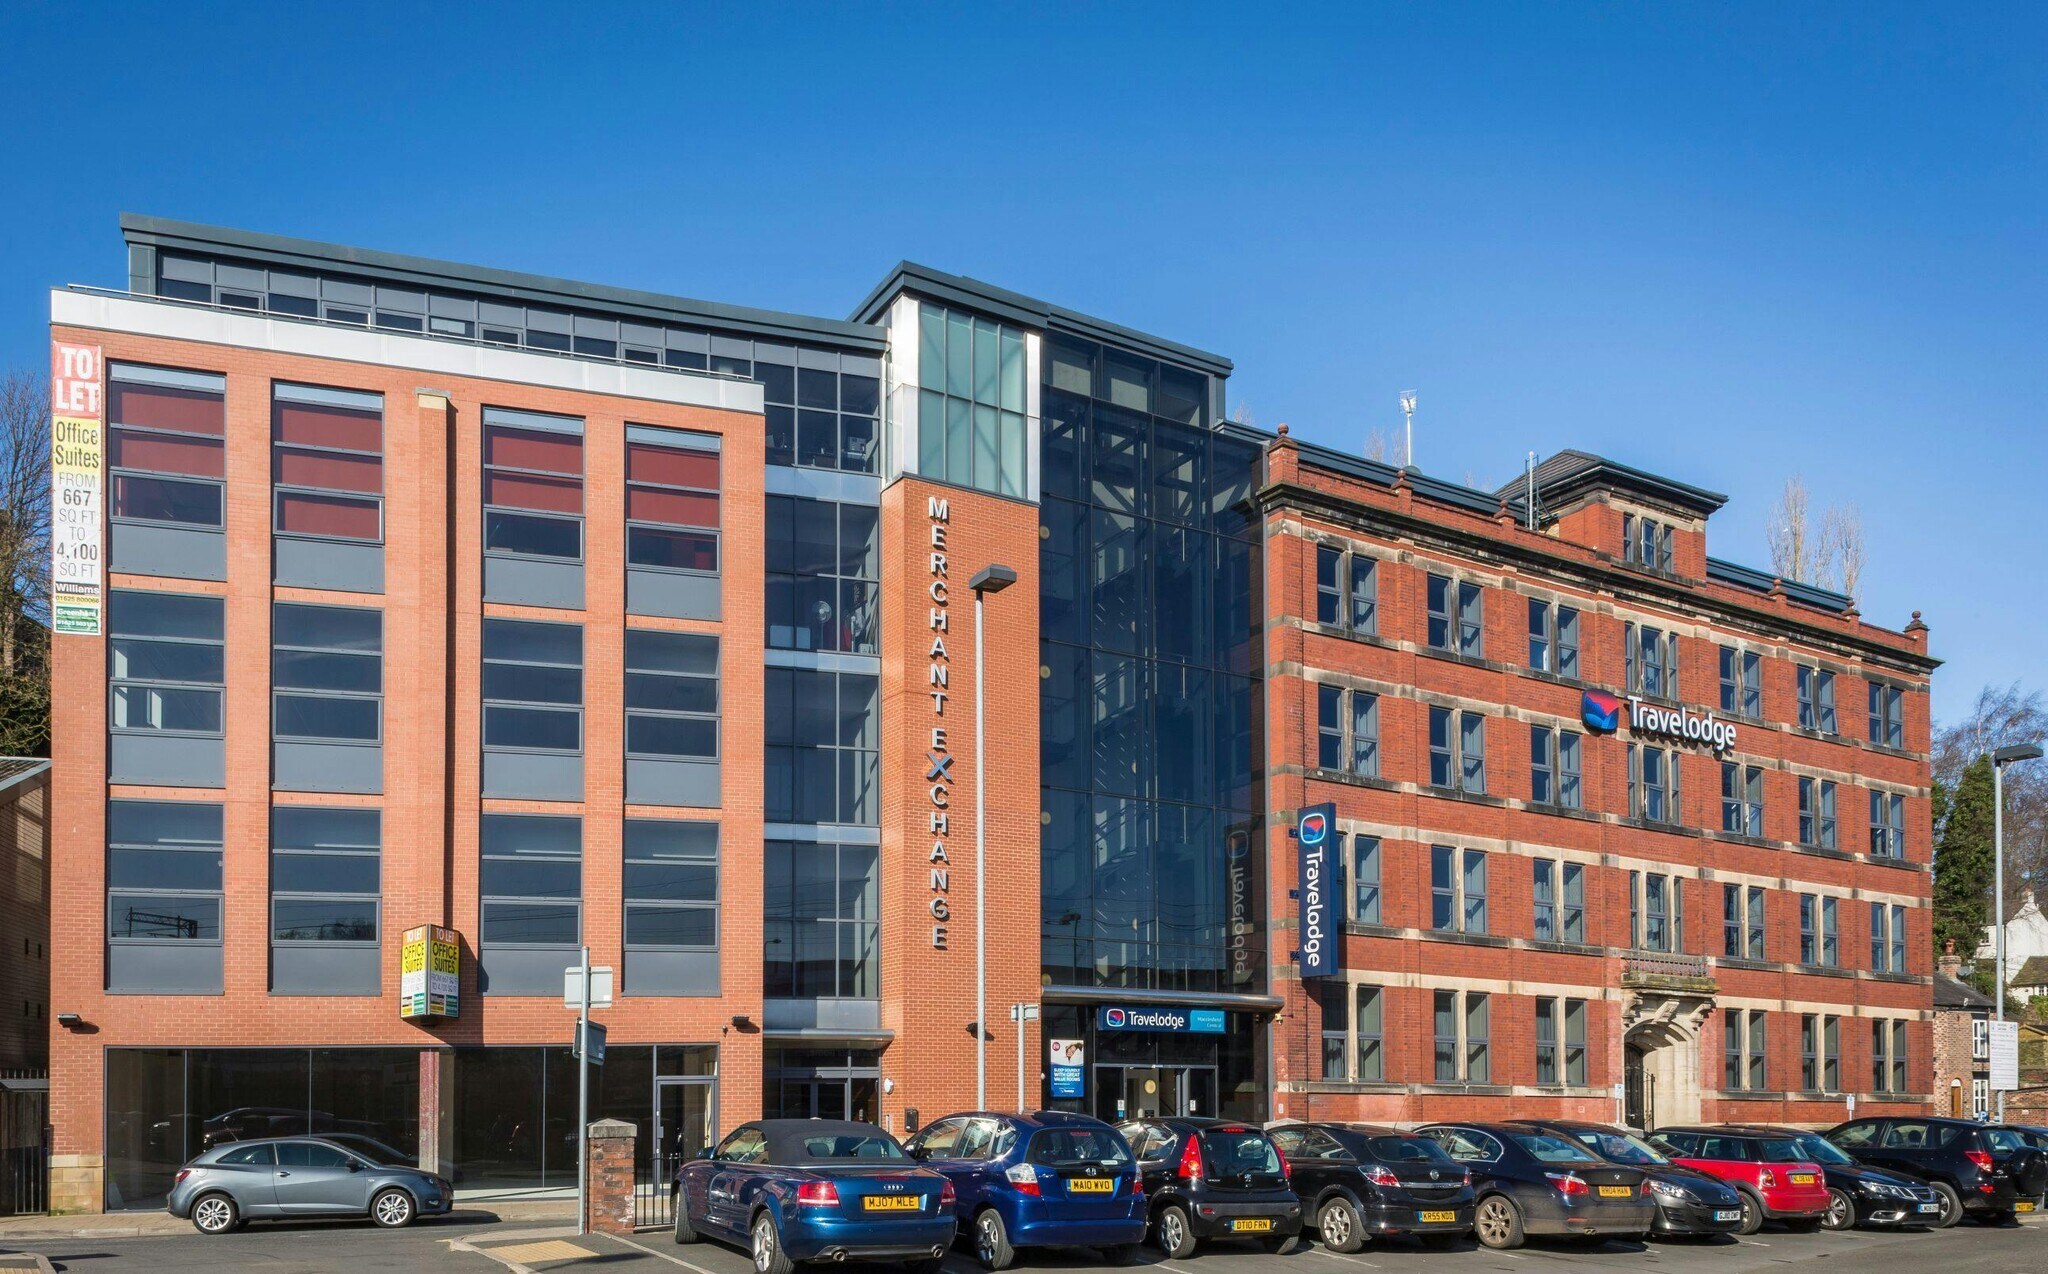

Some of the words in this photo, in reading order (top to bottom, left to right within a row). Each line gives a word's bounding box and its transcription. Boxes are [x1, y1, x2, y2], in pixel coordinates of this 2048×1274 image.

[61, 347, 93, 379] TO
[56, 378, 100, 412] LET
[56, 421, 98, 445] Office
[55, 445, 99, 468] Suites
[59, 472, 95, 488] FROM
[63, 488, 91, 506] 667
[59, 508, 77, 523] SQ
[81, 510, 95, 524] FT
[69, 526, 85, 541] TO
[59, 563, 77, 579] SQ
[81, 565, 95, 579] FT
[56, 583, 99, 594] Williams
[928, 496, 948, 713] MERCHANT
[1627, 695, 1737, 750] Travelodge
[926, 727, 952, 947] EXCHANGE
[1304, 845, 1324, 967] Travelodge
[436, 927, 445, 940] TO
[445, 930, 455, 943] LET
[404, 942, 424, 959] OFFICE
[433, 942, 457, 960] OFFICE
[405, 957, 423, 973] SUITES
[434, 957, 456, 974] SUITES
[1128, 1011, 1184, 1029] Travelodge
[1073, 1180, 1092, 1190] MA10
[869, 1197, 894, 1207] MJ07
[896, 1197, 914, 1206] MLE
[1236, 1221, 1253, 1229] DT10
[1423, 1212, 1441, 1221] KR55
